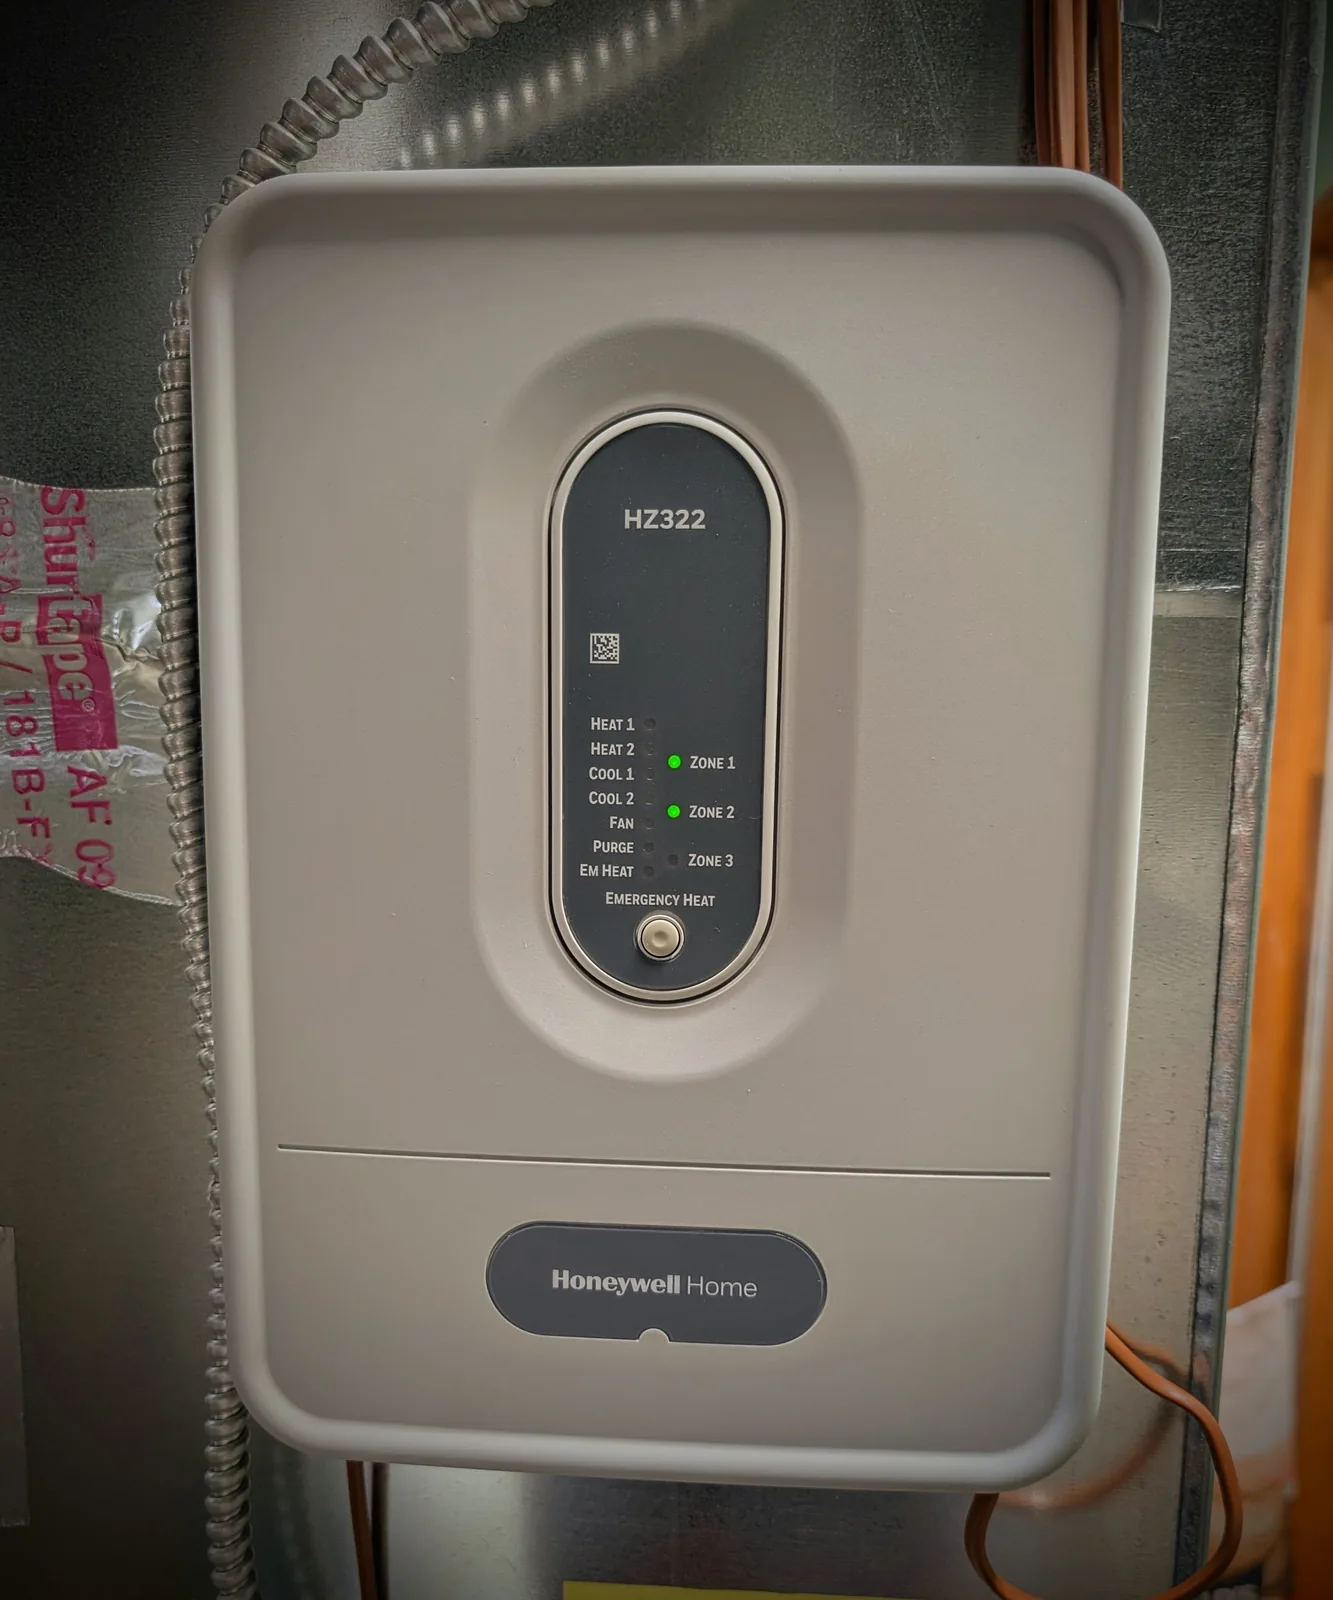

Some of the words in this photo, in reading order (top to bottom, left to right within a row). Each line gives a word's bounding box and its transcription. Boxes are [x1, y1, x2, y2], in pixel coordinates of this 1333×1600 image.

[625, 509, 705, 529] HZ322
[591, 717, 623, 730] HEAT
[626, 718, 635, 730] 1
[591, 742, 623, 755] HEAT
[627, 743, 634, 755] 2
[690, 756, 724, 769] ZONE
[727, 756, 735, 769] 1
[589, 767, 623, 780] COOL
[626, 768, 634, 780] 1
[67, 766, 112, 825] AF
[589, 791, 622, 804] COOL
[626, 792, 634, 805] 2
[689, 805, 723, 818] ZONE
[727, 806, 734, 818] 2
[610, 816, 633, 829] FAN
[594, 840, 634, 853] PURGE
[75, 839, 117, 888] 09
[688, 854, 722, 866] ZONE
[725, 854, 733, 867] 3
[580, 864, 598, 876] EM
[602, 864, 634, 877] HEAT
[606, 892, 680, 906] EMERGENCY
[684, 894, 715, 906] HEAT
[552, 1269, 680, 1296] Honeywell
[688, 1276, 757, 1297] Home
